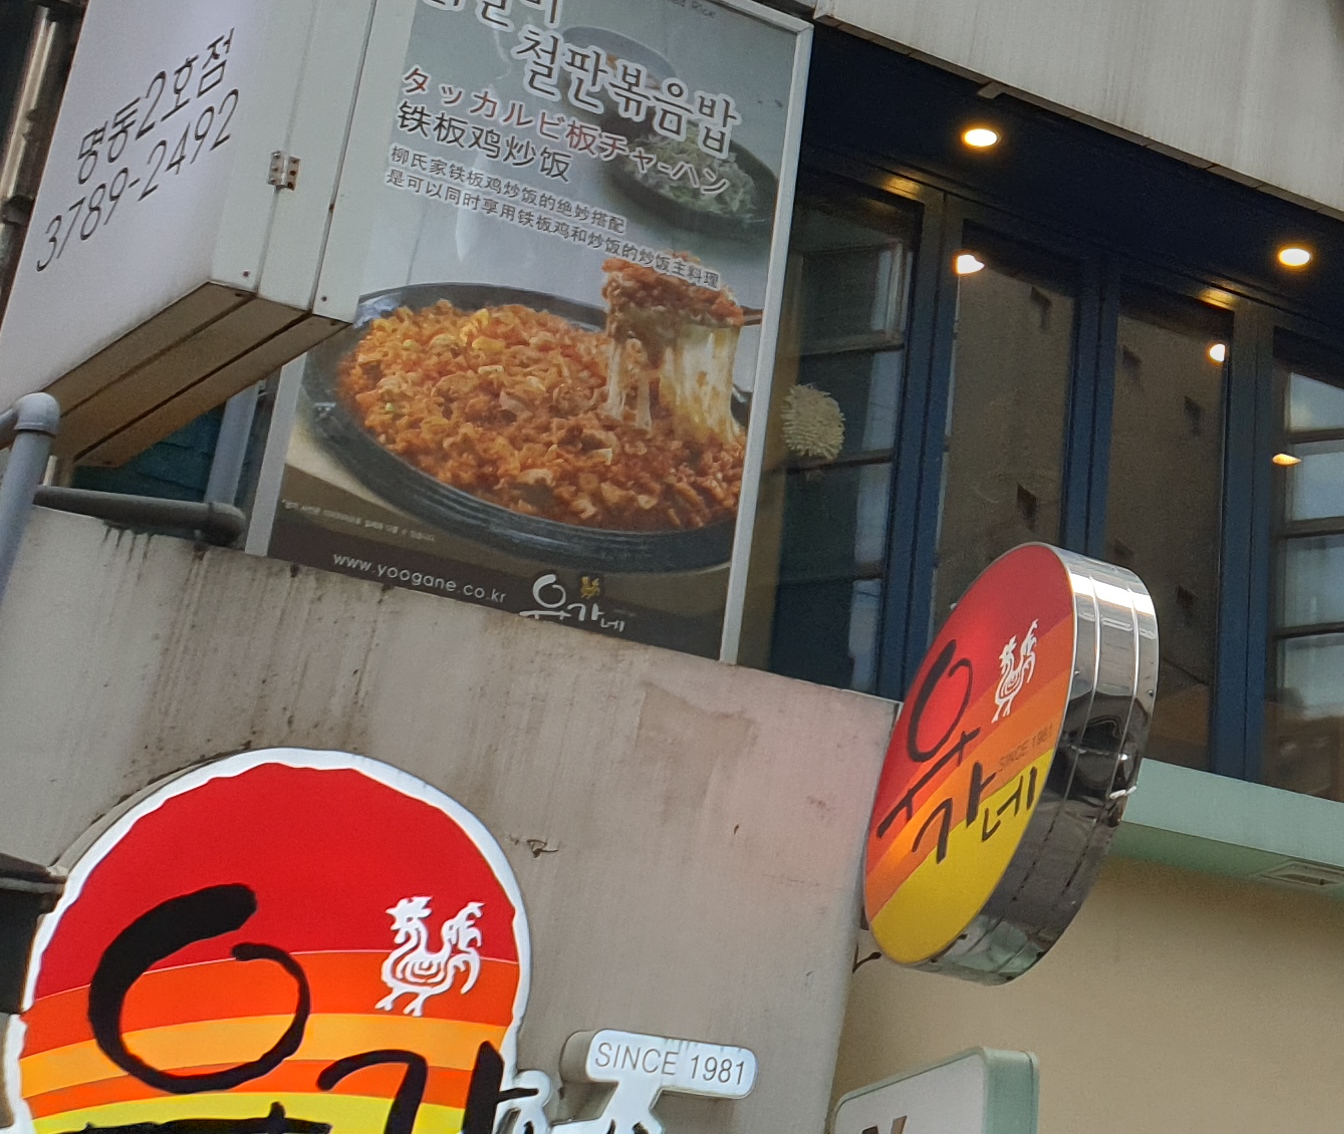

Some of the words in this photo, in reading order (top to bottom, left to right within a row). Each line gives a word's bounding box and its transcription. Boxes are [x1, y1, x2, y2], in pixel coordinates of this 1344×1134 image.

[76, 27, 236, 185] 명동2호점
[396, 101, 574, 183] 铁板鸡炒饭
[514, 28, 741, 156] 철판볶음밥
[36, 88, 240, 273] 3789-2492
[332, 553, 507, 604] www.yoogane.co.kr
[519, 572, 626, 633] 유가네
[876, 638, 1038, 865] 유가네
[594, 1041, 678, 1077] SINCE
[688, 1052, 746, 1087] 1981
